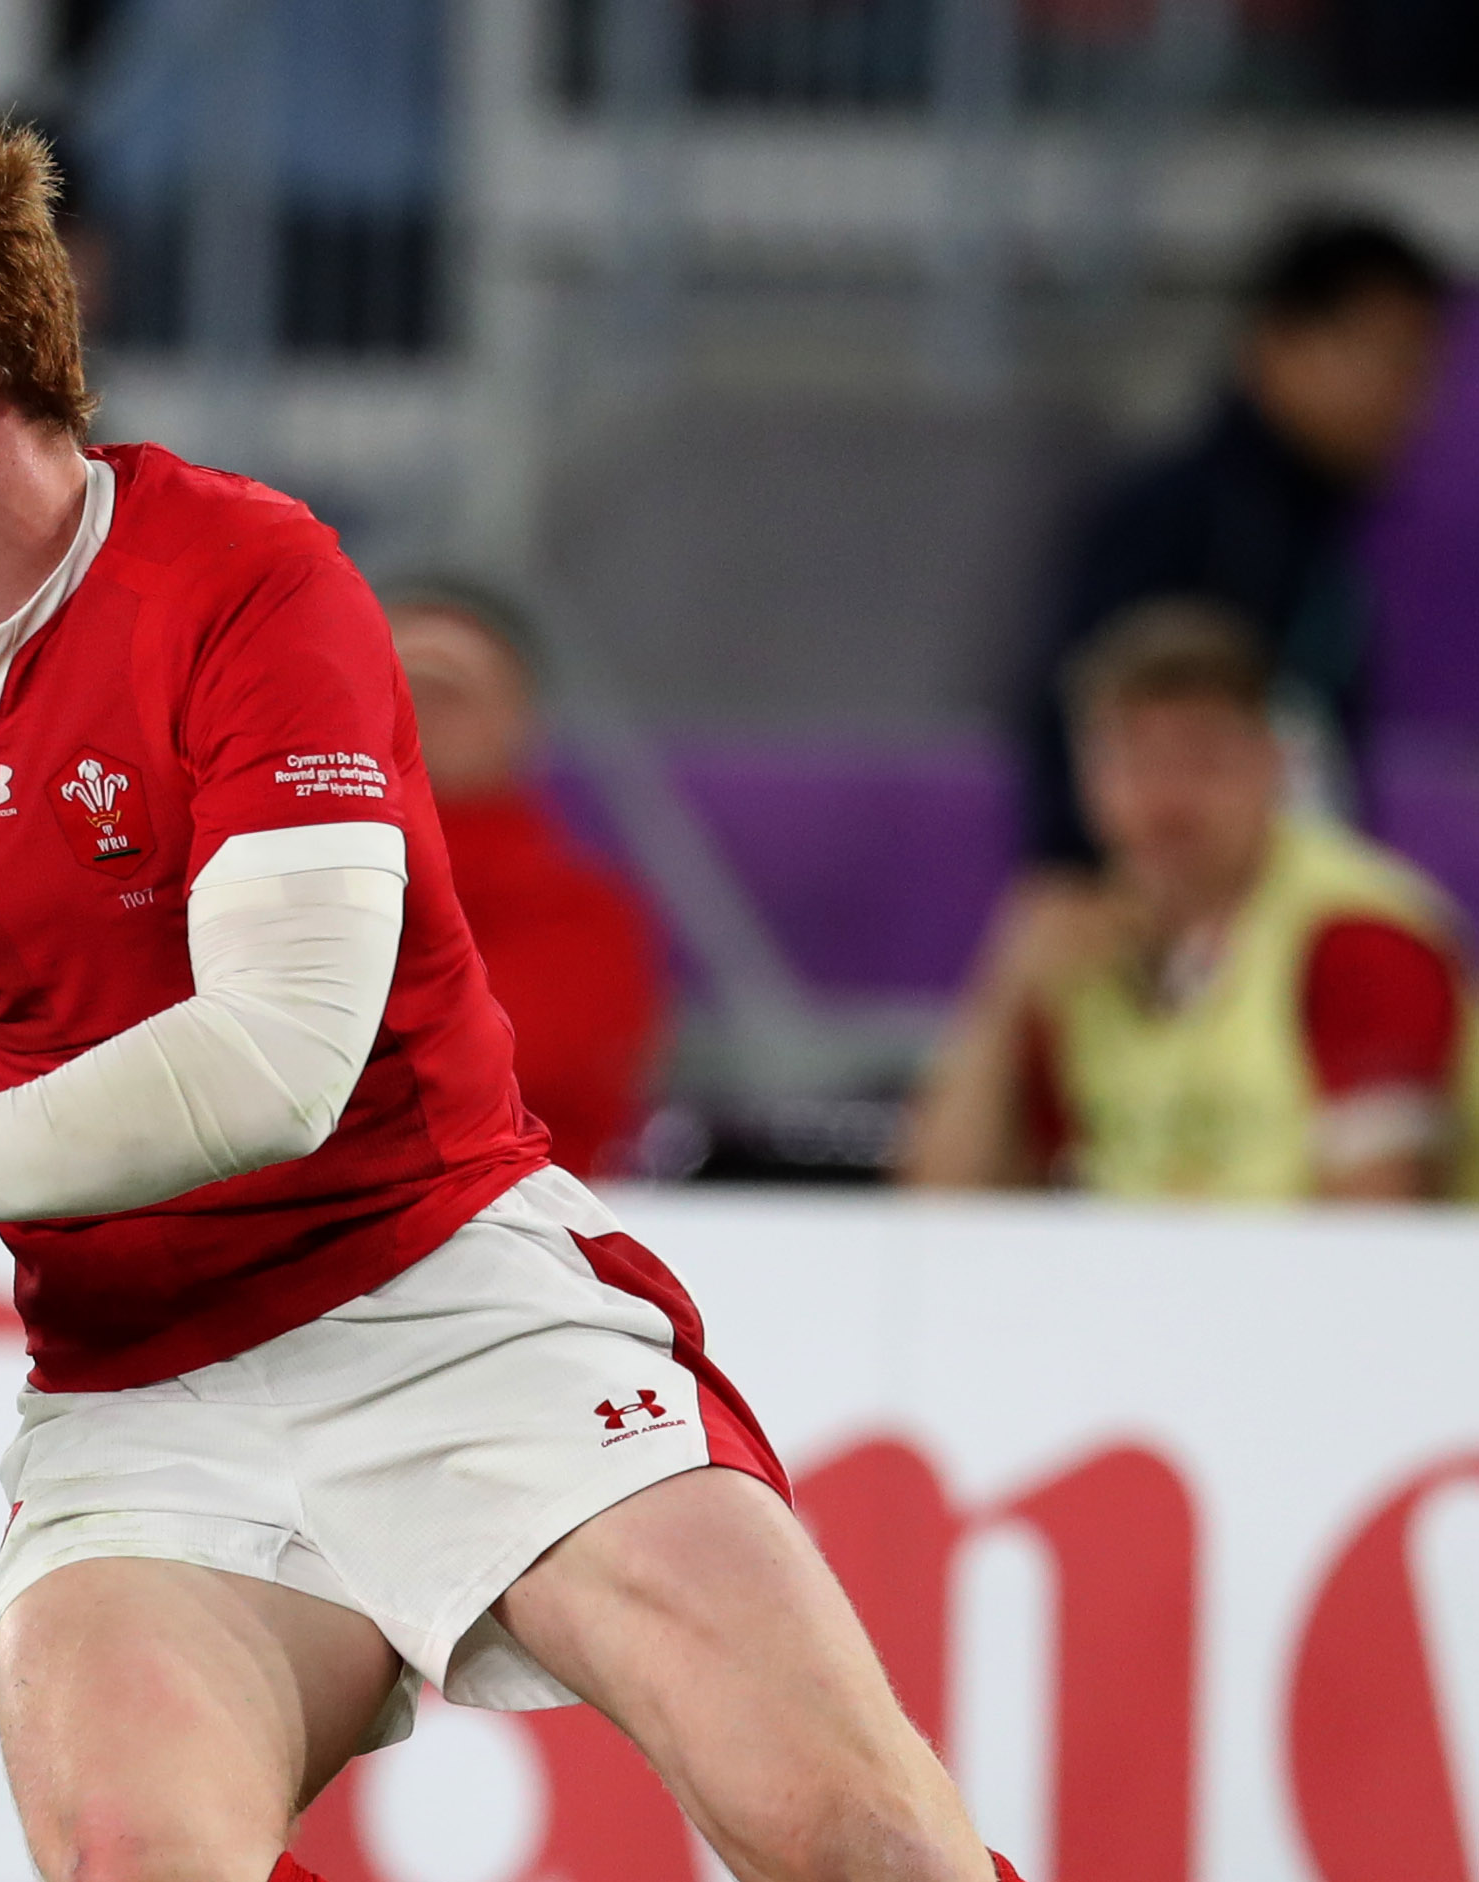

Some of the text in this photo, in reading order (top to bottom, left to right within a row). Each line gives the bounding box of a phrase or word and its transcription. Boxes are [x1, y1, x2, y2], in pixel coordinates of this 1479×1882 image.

[287, 754, 326, 769] Cymru
[275, 767, 315, 783] Rownd
[96, 835, 128, 852] WRU
[120, 888, 154, 909] 1107
[601, 1419, 686, 1448] UNDER ARMOUR
